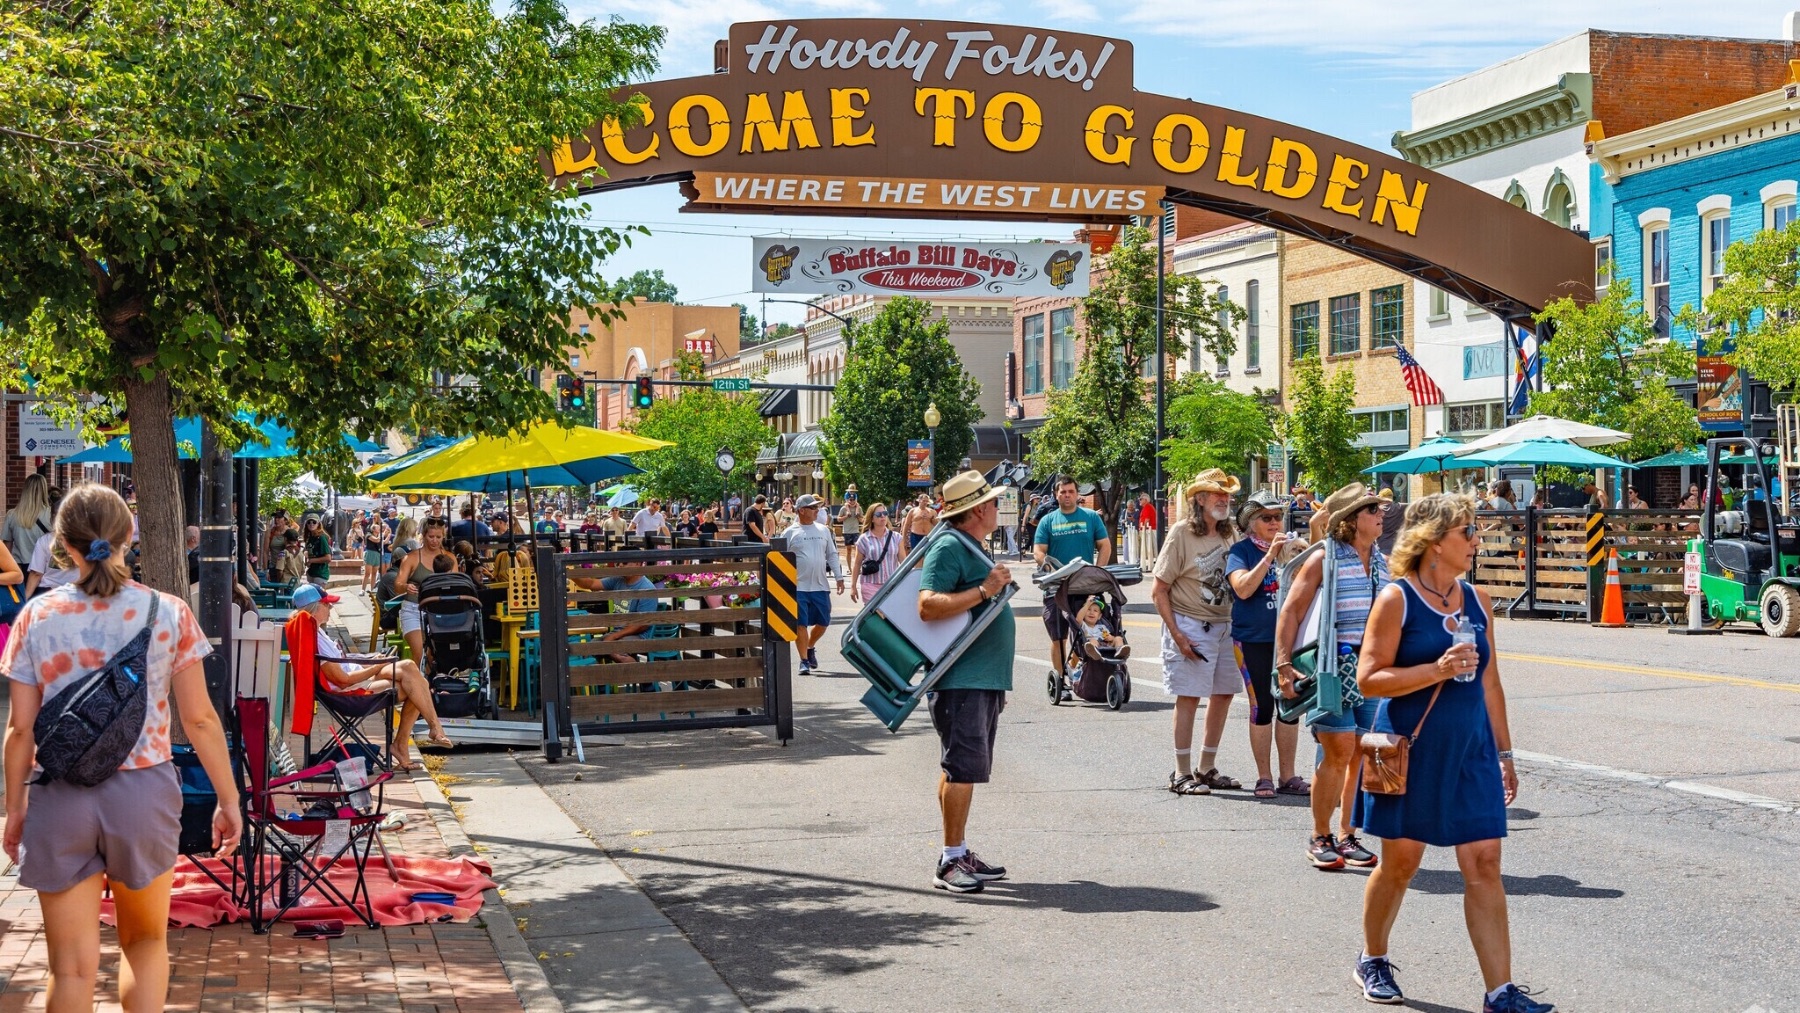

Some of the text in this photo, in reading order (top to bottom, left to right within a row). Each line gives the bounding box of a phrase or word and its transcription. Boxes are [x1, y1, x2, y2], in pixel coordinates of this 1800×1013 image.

[745, 24, 1116, 91] Howdy Folks!
[551, 87, 1431, 237] LCOME TO GOLDEN
[715, 177, 1147, 211] WHERE THE WEST LIVES
[828, 245, 1017, 277] Buffalo Bill Days
[880, 271, 966, 287] This Weekend
[686, 340, 713, 353] BAR
[714, 380, 749, 390] 12th St
[287, 868, 296, 895] IKON
